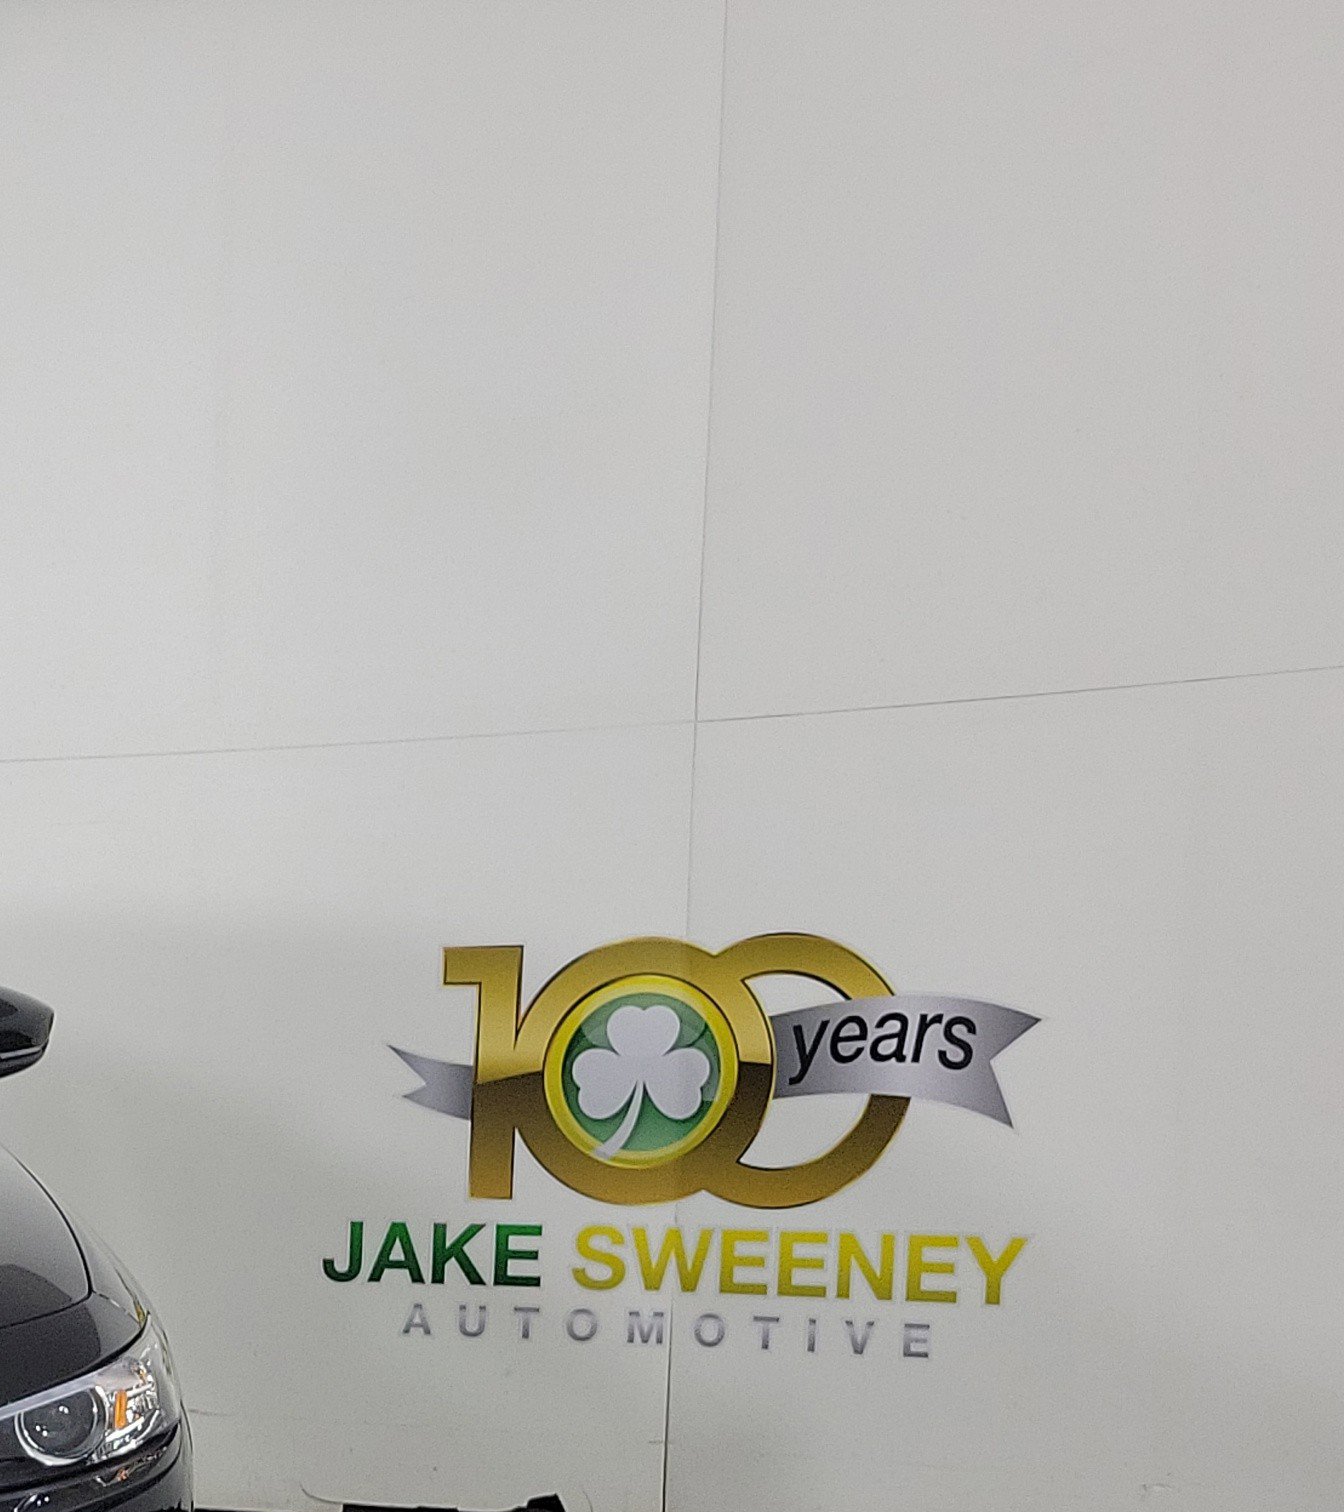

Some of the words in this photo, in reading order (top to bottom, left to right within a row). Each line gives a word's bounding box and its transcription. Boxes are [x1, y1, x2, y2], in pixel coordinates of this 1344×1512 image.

[788, 1009, 978, 1086] years
[321, 1221, 543, 1288] JAKE
[571, 1225, 1028, 1306] SWEENEY
[402, 1303, 930, 1359] AUTOMOTIVE
